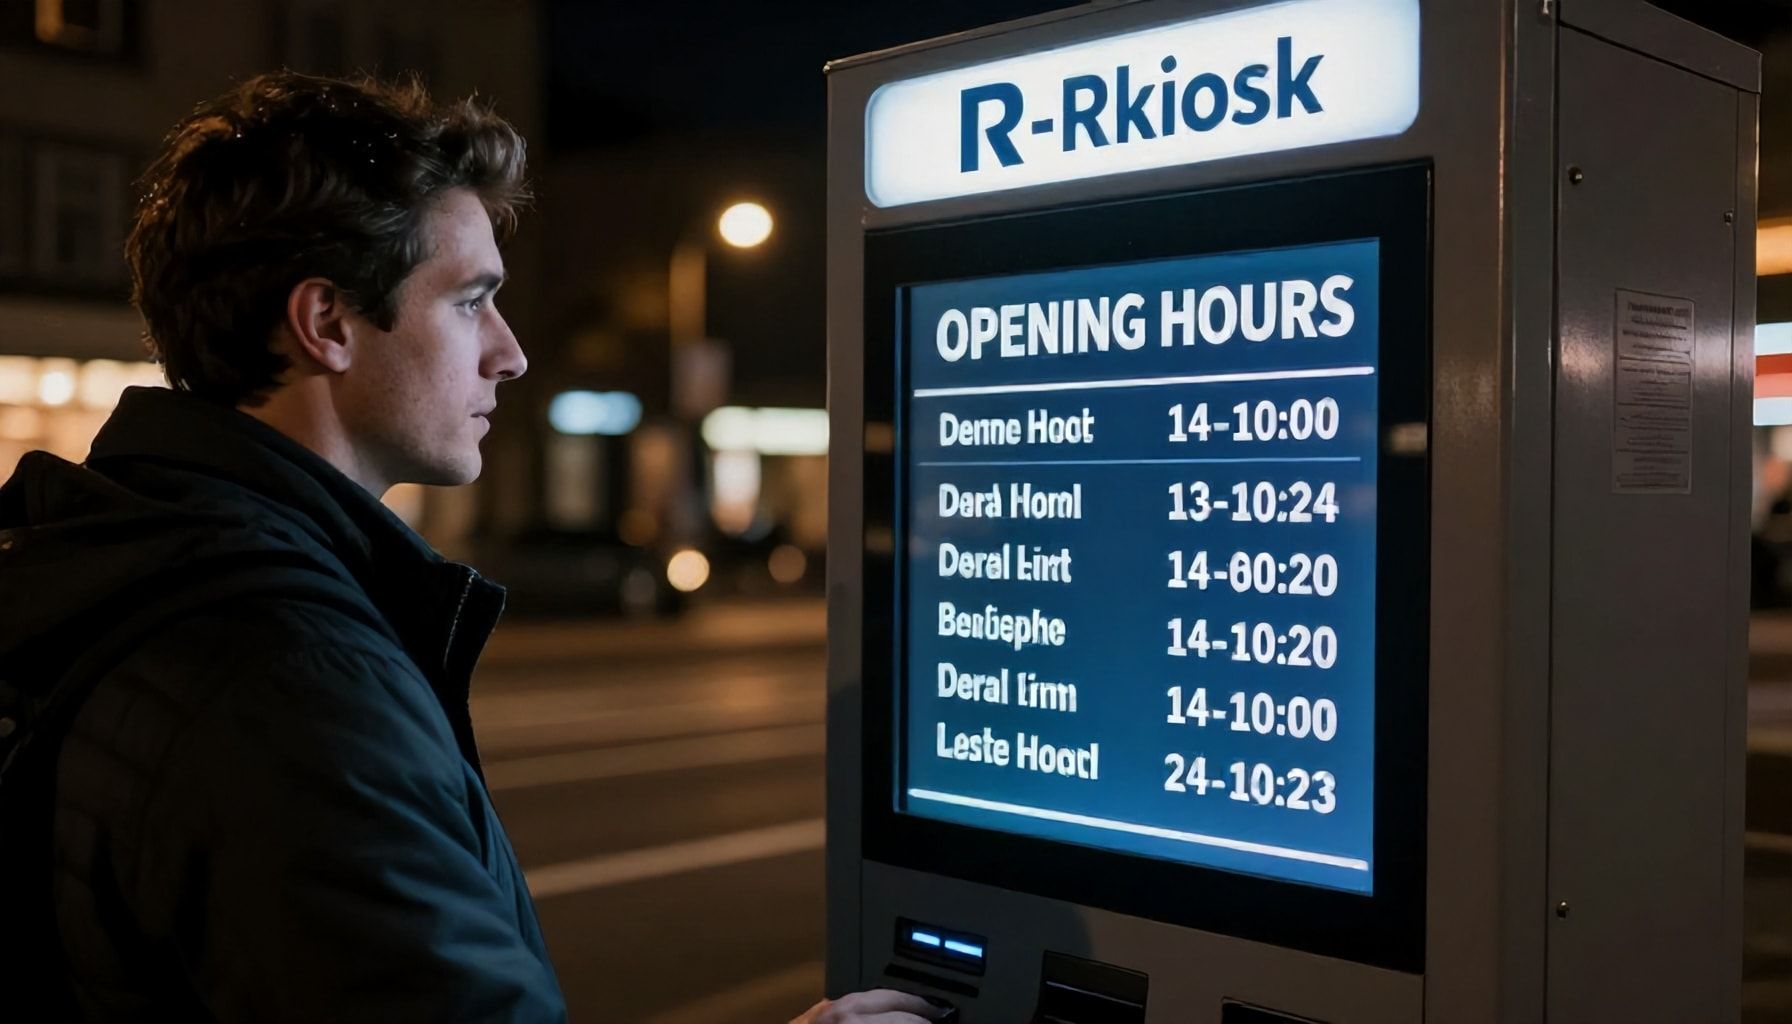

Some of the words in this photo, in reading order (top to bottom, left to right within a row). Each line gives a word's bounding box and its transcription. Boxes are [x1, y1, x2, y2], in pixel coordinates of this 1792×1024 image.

[960, 36, 1324, 173] R-Rkiosk
[937, 293, 1145, 362] OPENING
[1161, 275, 1354, 346] HOURS
[1169, 397, 1339, 441] 14-10:00
[1169, 481, 1339, 523] 13-10:24
[1168, 551, 1338, 596] 14-60:20
[1167, 618, 1338, 669] 14-10:20
[938, 663, 1009, 705] Deral
[1167, 687, 1337, 741] 14-10:00
[937, 723, 1009, 766] Leste
[1165, 753, 1336, 813] 24-10:23
